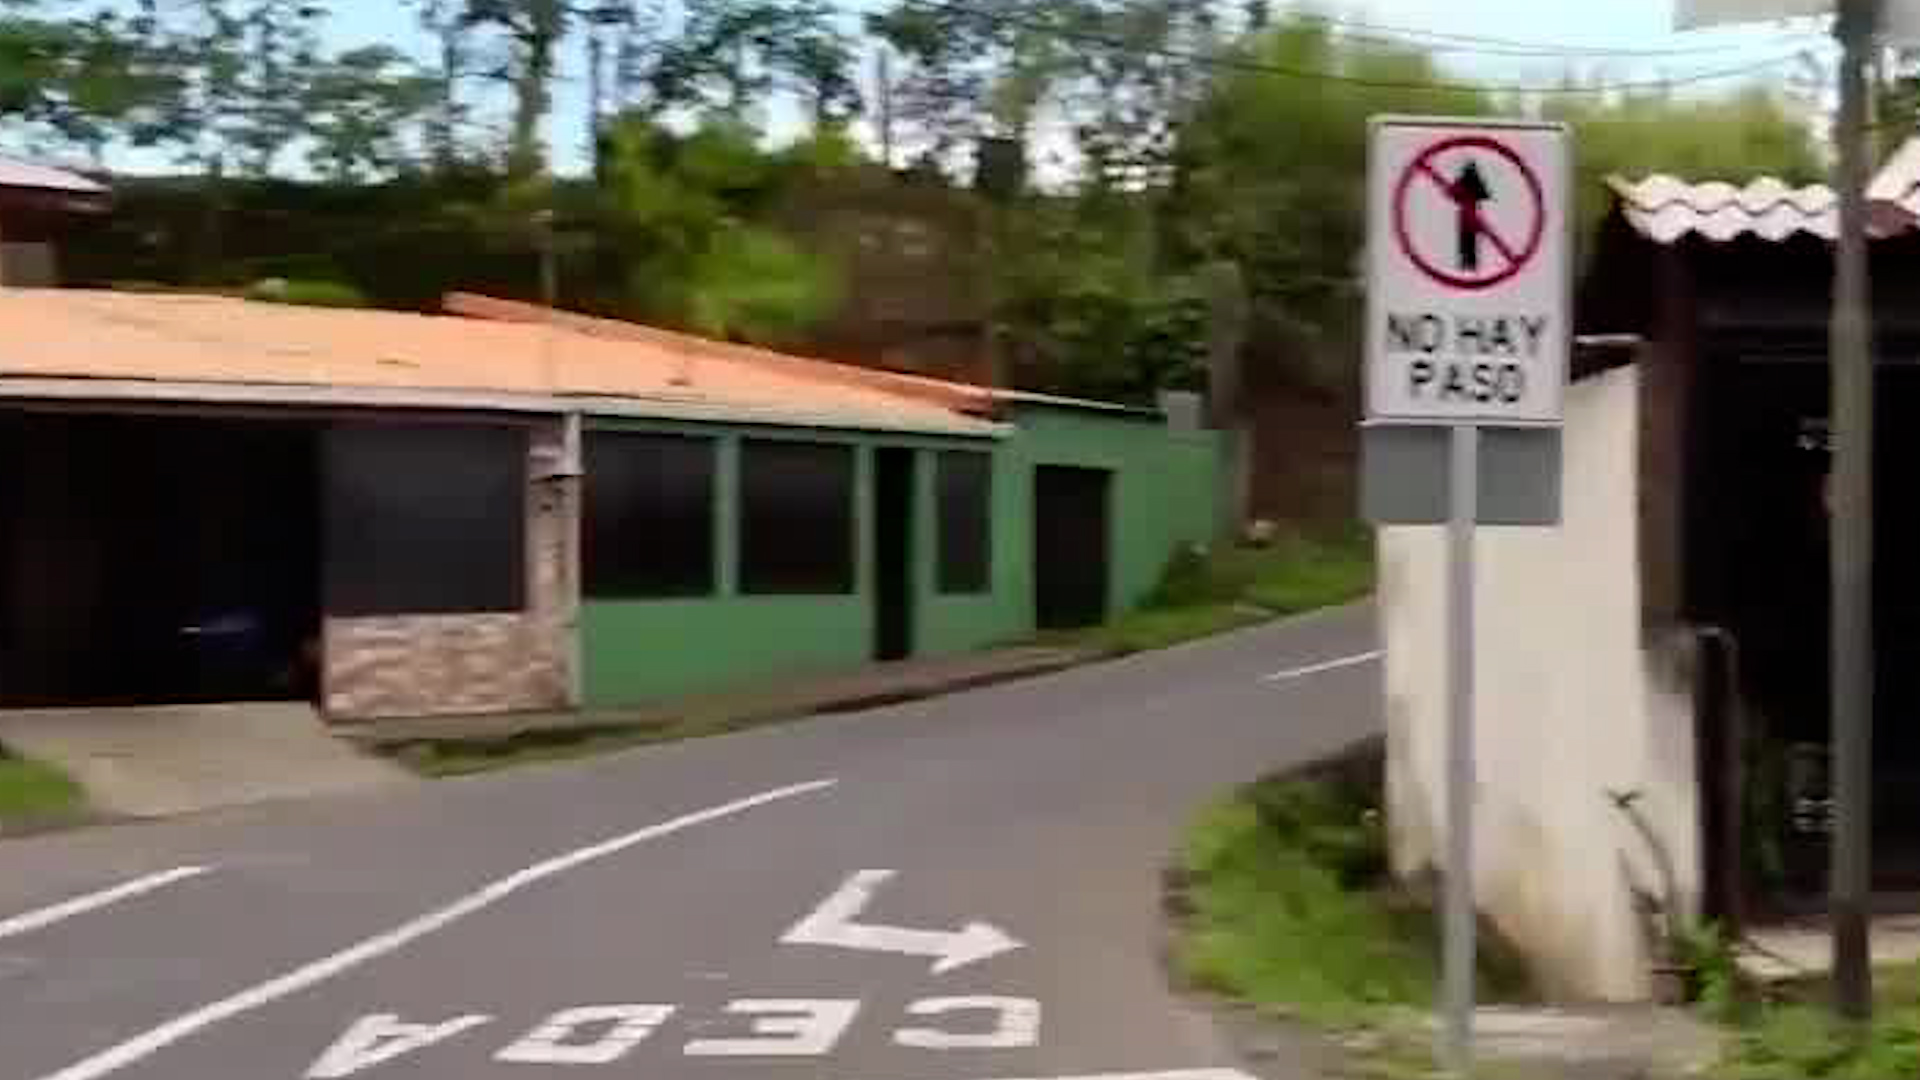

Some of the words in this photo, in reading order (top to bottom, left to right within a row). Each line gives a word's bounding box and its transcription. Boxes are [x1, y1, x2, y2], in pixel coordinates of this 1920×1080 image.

[1387, 313, 1443, 353] NO
[1455, 313, 1547, 354] HAY
[1410, 361, 1523, 403] PASO
[303, 995, 1041, 1079] CEDA
